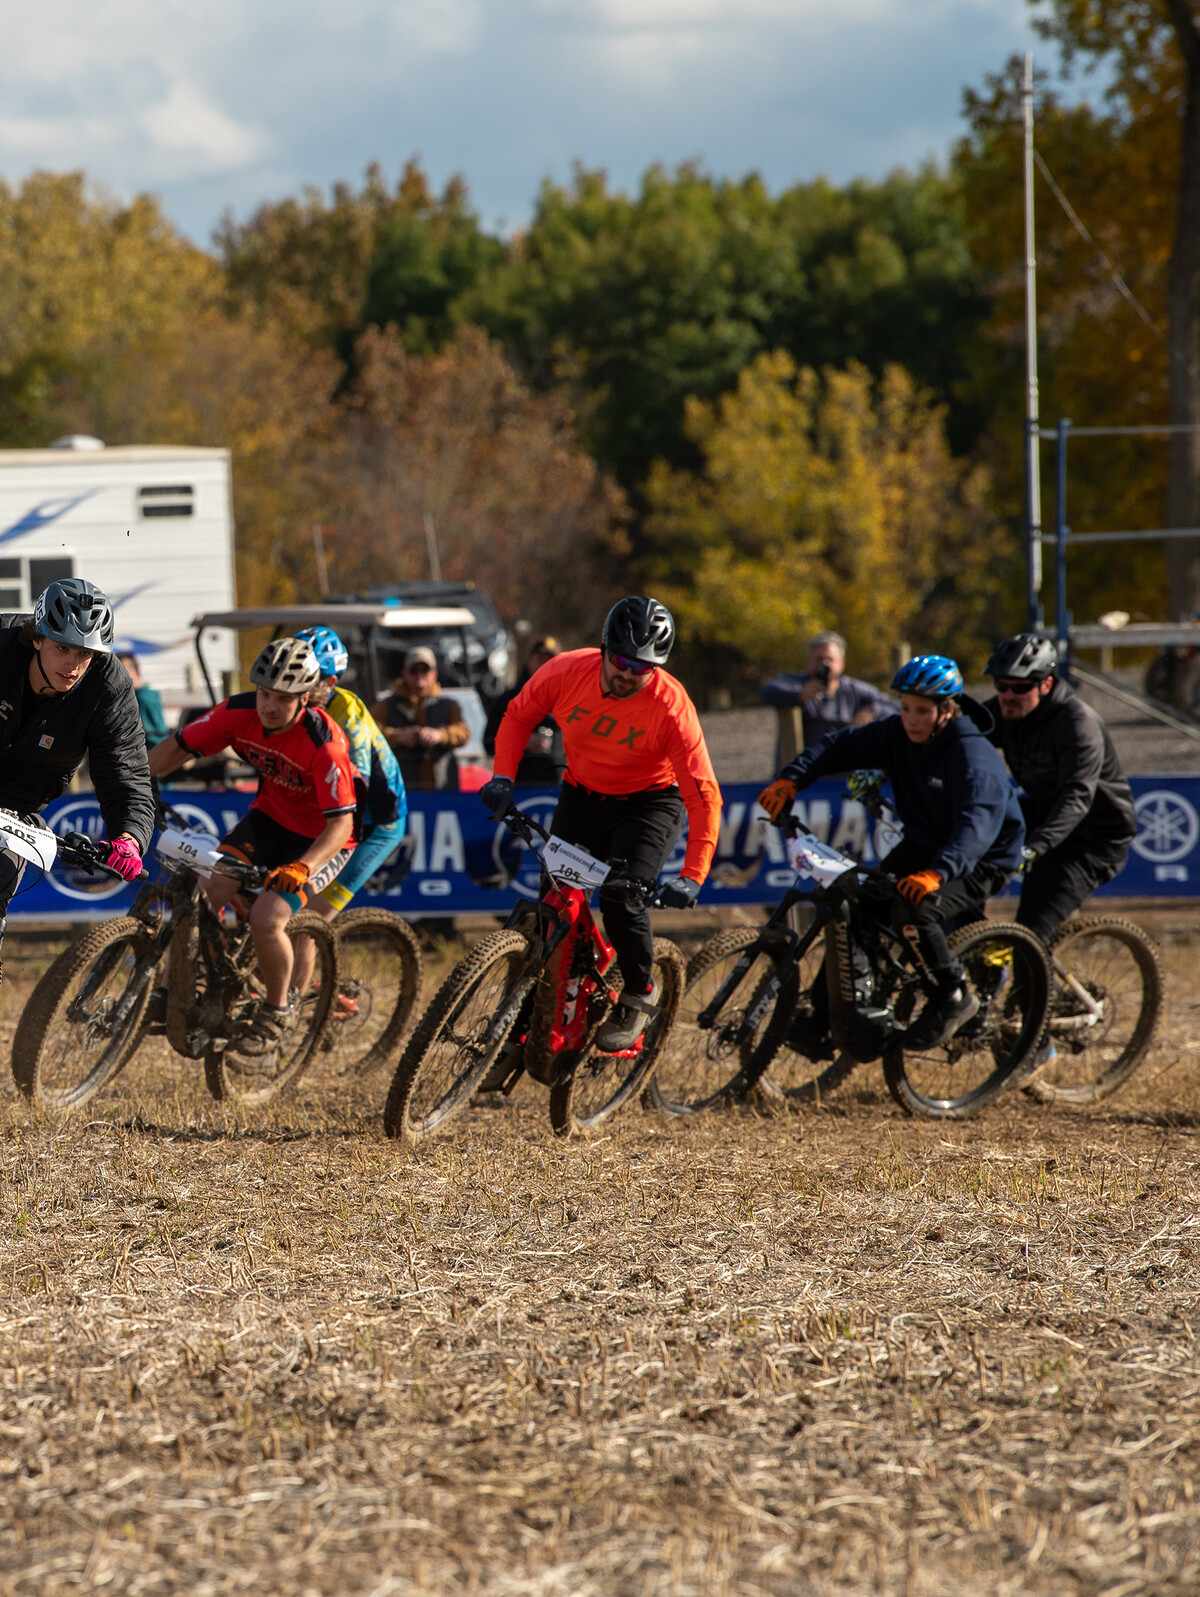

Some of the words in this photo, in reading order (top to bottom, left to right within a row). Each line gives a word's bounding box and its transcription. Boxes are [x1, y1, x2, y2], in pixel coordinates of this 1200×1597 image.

[566, 706, 646, 750] FOX
[2, 824, 37, 845] 405
[177, 841, 198, 858] 104
[558, 846, 607, 876] GNCCRACINGCOM
[559, 863, 582, 882] 105
